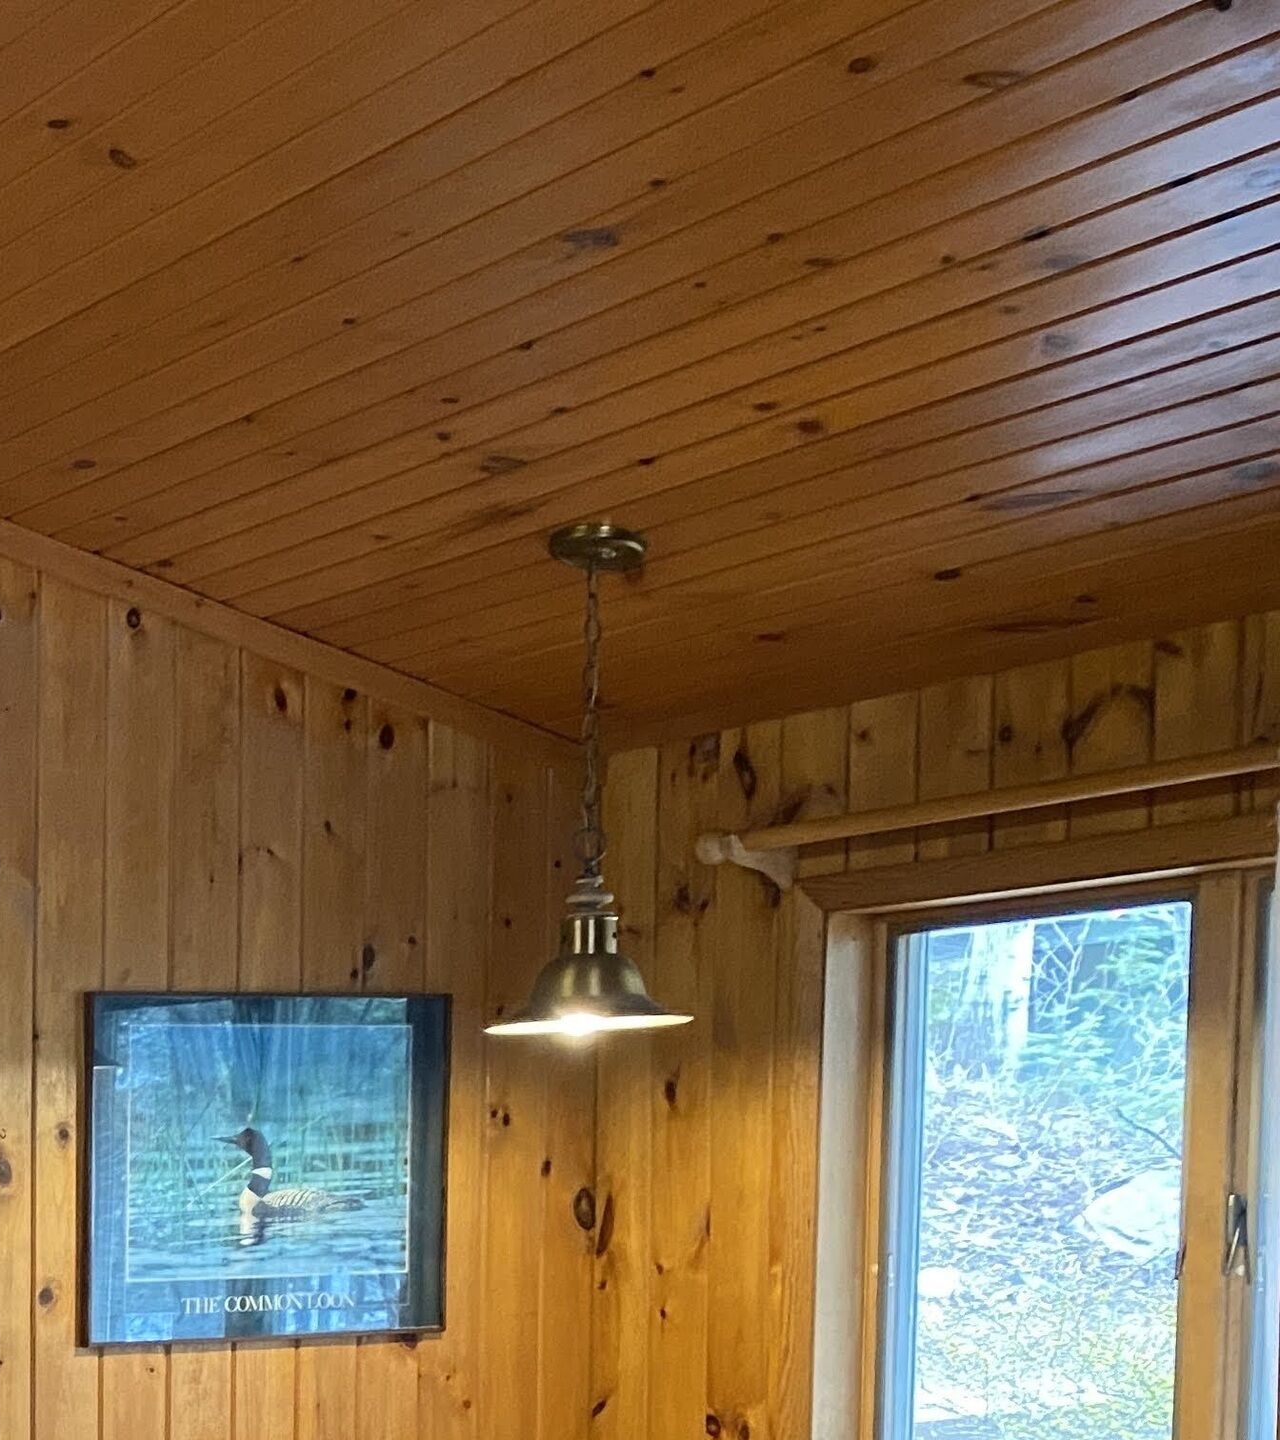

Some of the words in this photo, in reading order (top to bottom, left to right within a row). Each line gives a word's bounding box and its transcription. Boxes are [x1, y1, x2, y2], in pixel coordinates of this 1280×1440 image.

[180, 1296, 221, 1313] THE
[224, 1293, 305, 1312] COMMON
[306, 1292, 355, 1308] LOON
